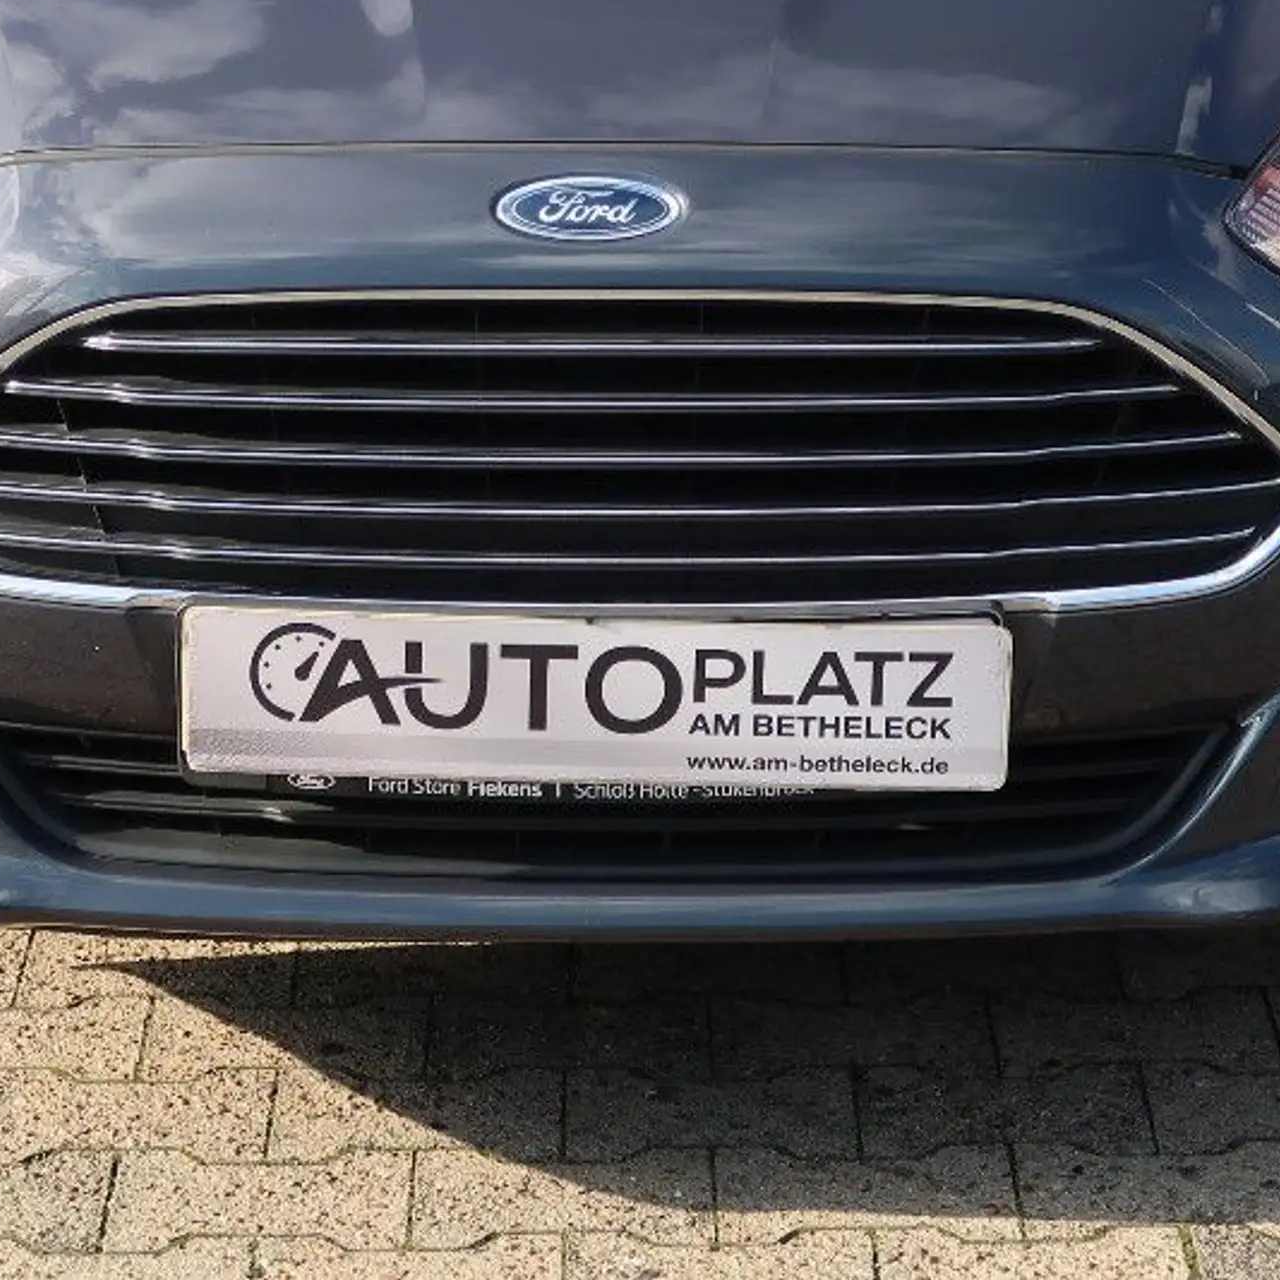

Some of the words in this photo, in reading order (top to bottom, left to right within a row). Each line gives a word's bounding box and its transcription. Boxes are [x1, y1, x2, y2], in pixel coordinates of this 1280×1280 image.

[539, 189, 636, 224] Ford
[688, 714, 741, 737] AM
[753, 715, 951, 740] BETHELECK
[686, 754, 949, 775] www.am-betheleck.de
[369, 777, 408, 793] Ford
[411, 777, 461, 796] Store
[467, 779, 543, 798] Fiekens
